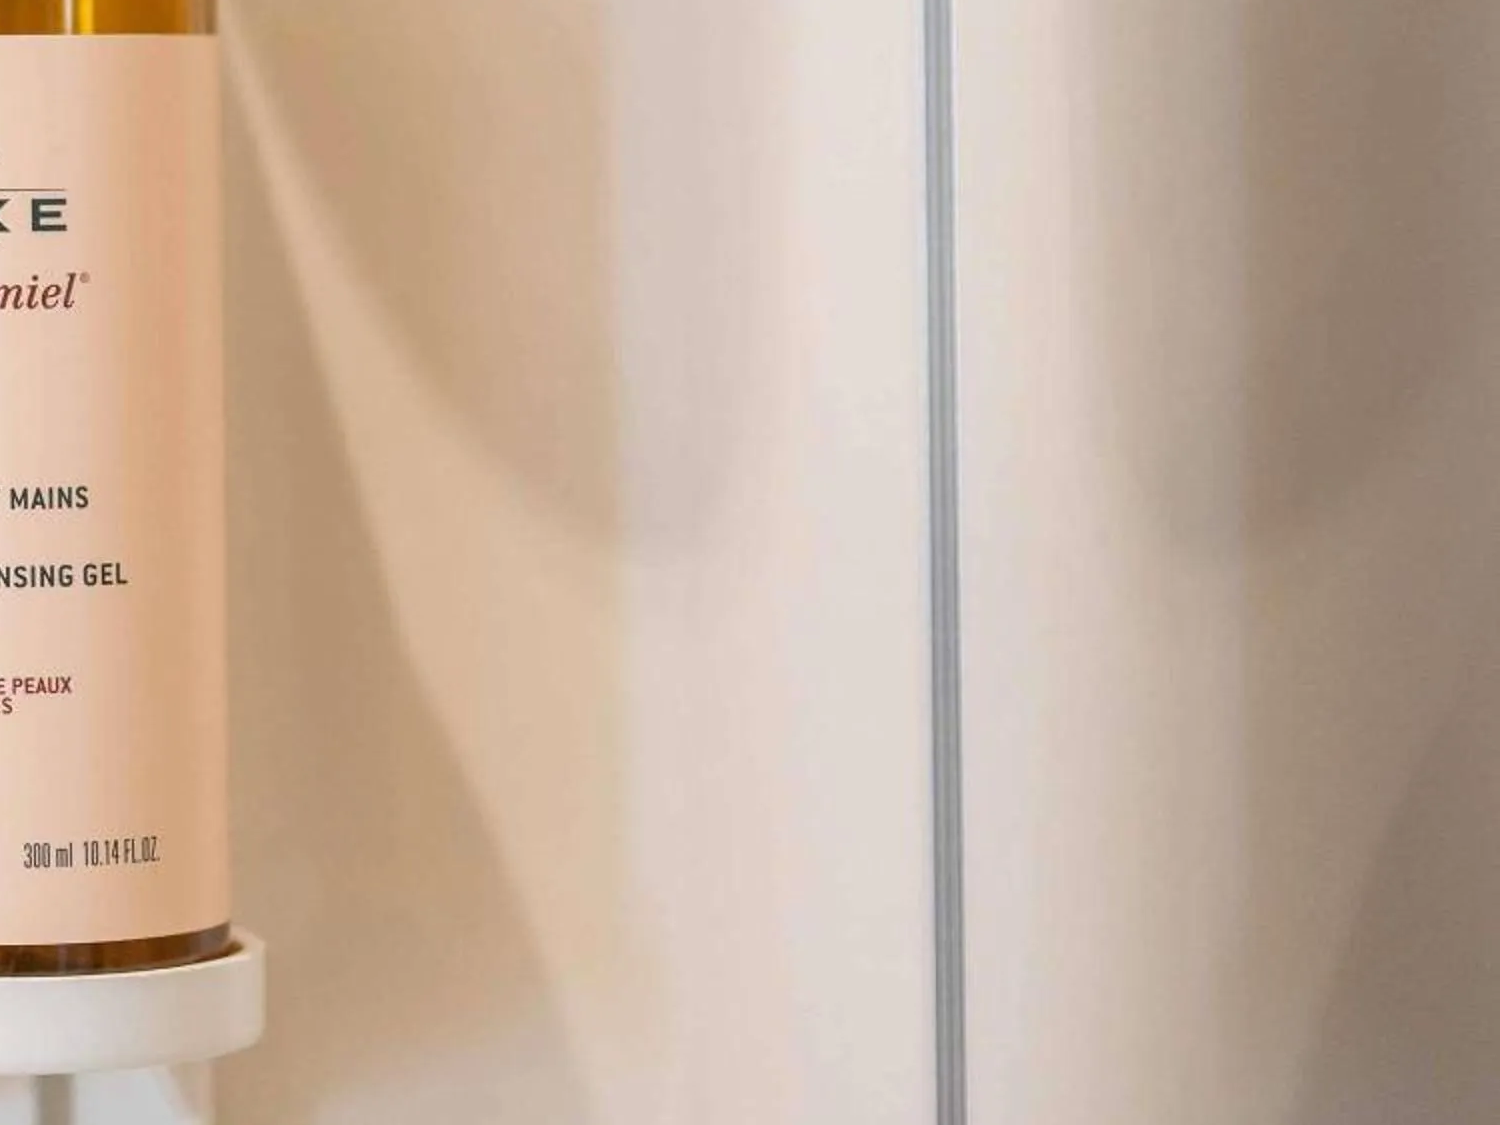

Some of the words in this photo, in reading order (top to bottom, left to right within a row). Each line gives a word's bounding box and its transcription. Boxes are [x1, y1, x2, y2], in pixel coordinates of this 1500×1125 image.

[10, 486, 89, 510] MAINS
[83, 563, 128, 586] GEL
[12, 676, 72, 695] PEAUX
[23, 842, 51, 869] 300
[55, 842, 73, 868] ml
[83, 839, 119, 867] 10.14
